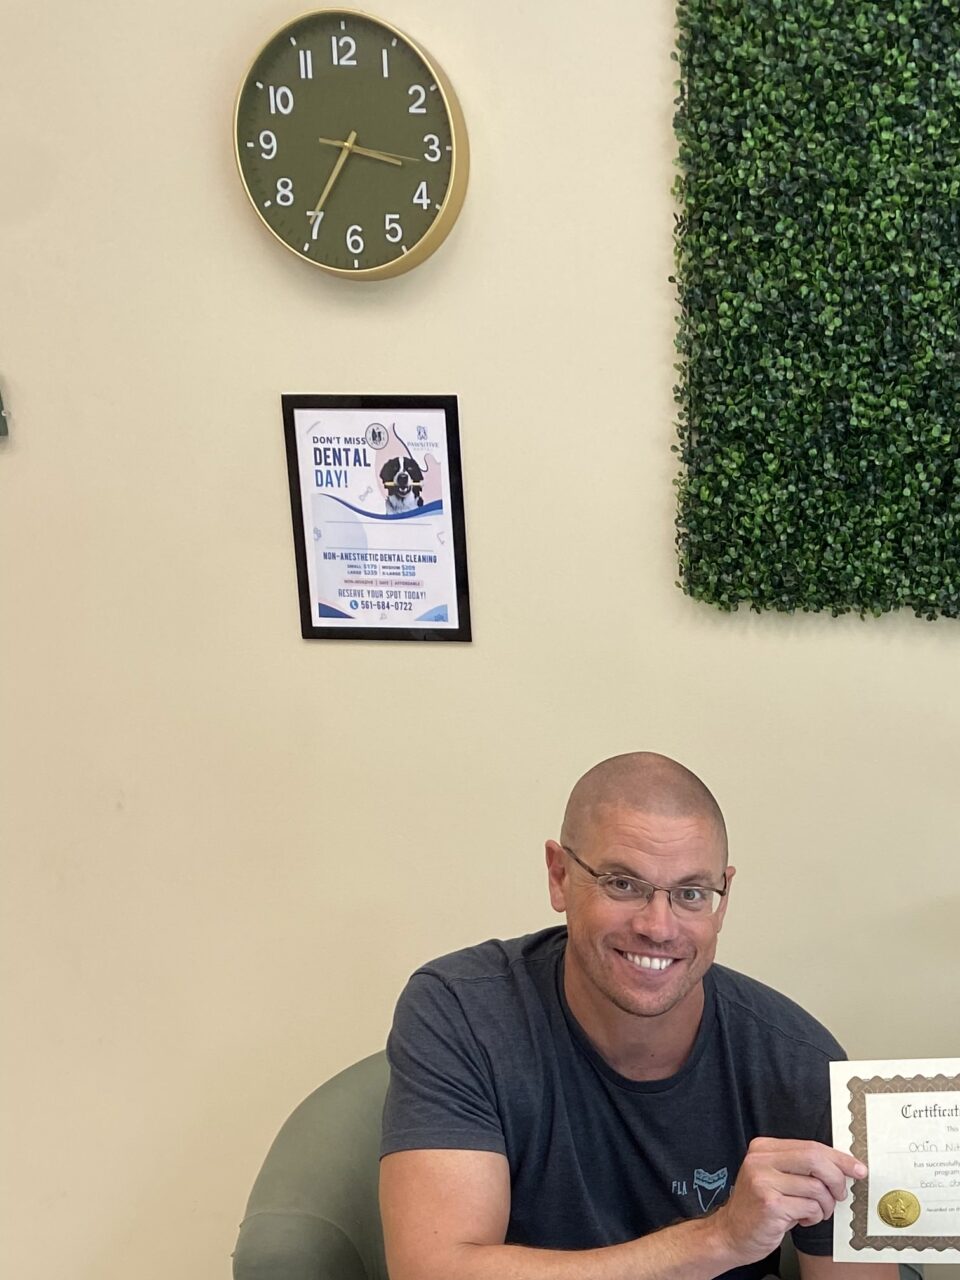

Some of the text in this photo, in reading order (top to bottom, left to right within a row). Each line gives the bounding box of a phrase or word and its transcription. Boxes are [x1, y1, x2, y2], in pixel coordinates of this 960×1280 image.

[299, 50, 312, 79] 11
[331, 36, 357, 65] 12
[382, 48, 389, 78] 1
[269, 85, 294, 114] 10
[408, 84, 427, 113] 2
[259, 130, 277, 160] 9
[423, 134, 441, 162] 3
[276, 178, 294, 206] 8
[412, 181, 431, 209] 4
[306, 211, 324, 239] 7
[346, 225, 364, 253] 6
[385, 214, 402, 242] 5
[312, 436, 367, 445] DON'T MISS
[313, 447, 371, 468] DENTAL
[315, 469, 348, 488] DAY!
[323, 552, 437, 564] NON-ANESTHETIC DENTAL CLEANING
[338, 589, 426, 600] RESERVE YOUR SPOT TODAY!
[361, 601, 413, 611] 561-684-0722
[926, 1160, 960, 1168] successfully
[934, 1169, 959, 1177] program
